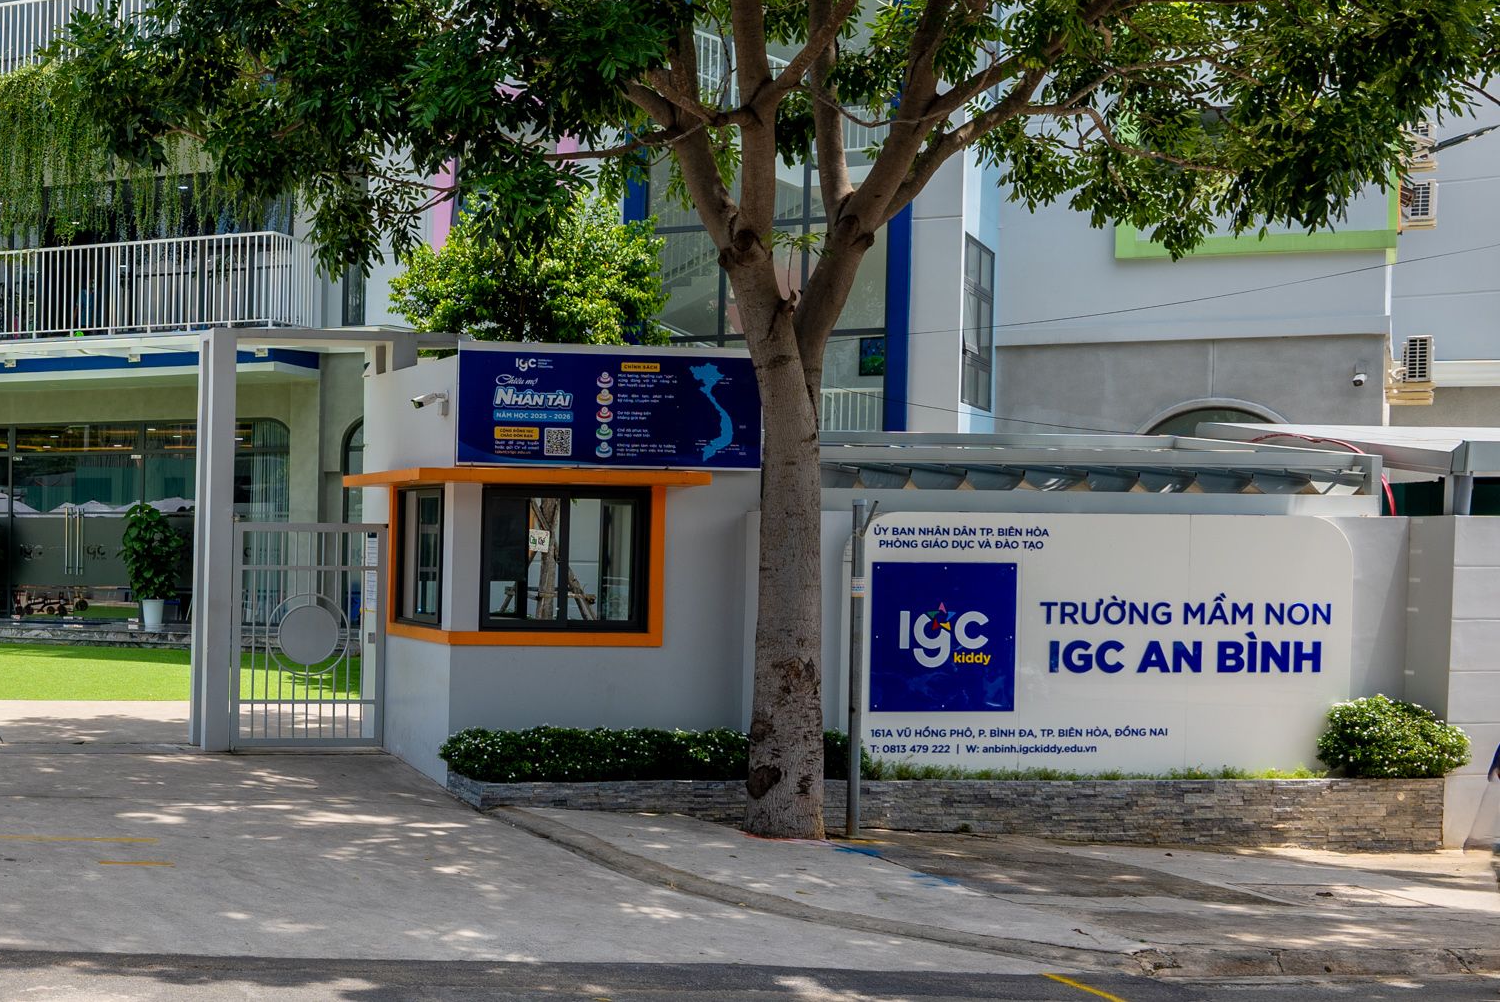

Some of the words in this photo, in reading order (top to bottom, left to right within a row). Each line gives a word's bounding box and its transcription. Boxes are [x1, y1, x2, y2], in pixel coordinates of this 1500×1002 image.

[495, 388, 544, 406] NHÂN
[546, 392, 570, 406] TÀI
[874, 524, 889, 536] ỦY
[892, 527, 915, 536] BAN
[918, 525, 950, 536] NHÂN
[953, 526, 977, 536] DÂN
[980, 528, 995, 536] TP.
[998, 526, 1023, 537] BIÊN
[1026, 526, 1050, 537] HÒA
[879, 538, 918, 549] PHÒNG
[922, 537, 949, 549] GIÁO
[952, 540, 975, 551] DỤC
[978, 538, 992, 549] VÀ
[995, 539, 1020, 549] ĐÀO
[1022, 541, 1044, 552] TẠO
[1040, 596, 1172, 625] TRƯỜNG
[1183, 593, 1253, 625] MẦM
[1265, 603, 1332, 625] NON
[954, 652, 991, 665] kiddy
[1049, 640, 1125, 674] IGC
[1136, 641, 1203, 673] AN
[1217, 631, 1322, 674] BÌNH
[871, 729, 893, 738] 161A
[897, 727, 912, 738] VŨ
[950, 727, 976, 739] PHÔ,
[978, 729, 987, 738] P.
[990, 727, 1015, 738] BÌNH
[1018, 729, 1037, 739] ĐA,
[1040, 729, 1055, 738] TP.
[1058, 726, 1083, 738] BIÊN
[1086, 726, 1112, 738] HÒA,
[1150, 728, 1168, 736] NAI
[871, 745, 880, 753] T:
[882, 745, 907, 754] 0813
[910, 745, 929, 754] 479
[932, 745, 951, 753] 222
[966, 745, 979, 753] W:
[982, 744, 1097, 754] anbinh.igckiddy.edu.vn
